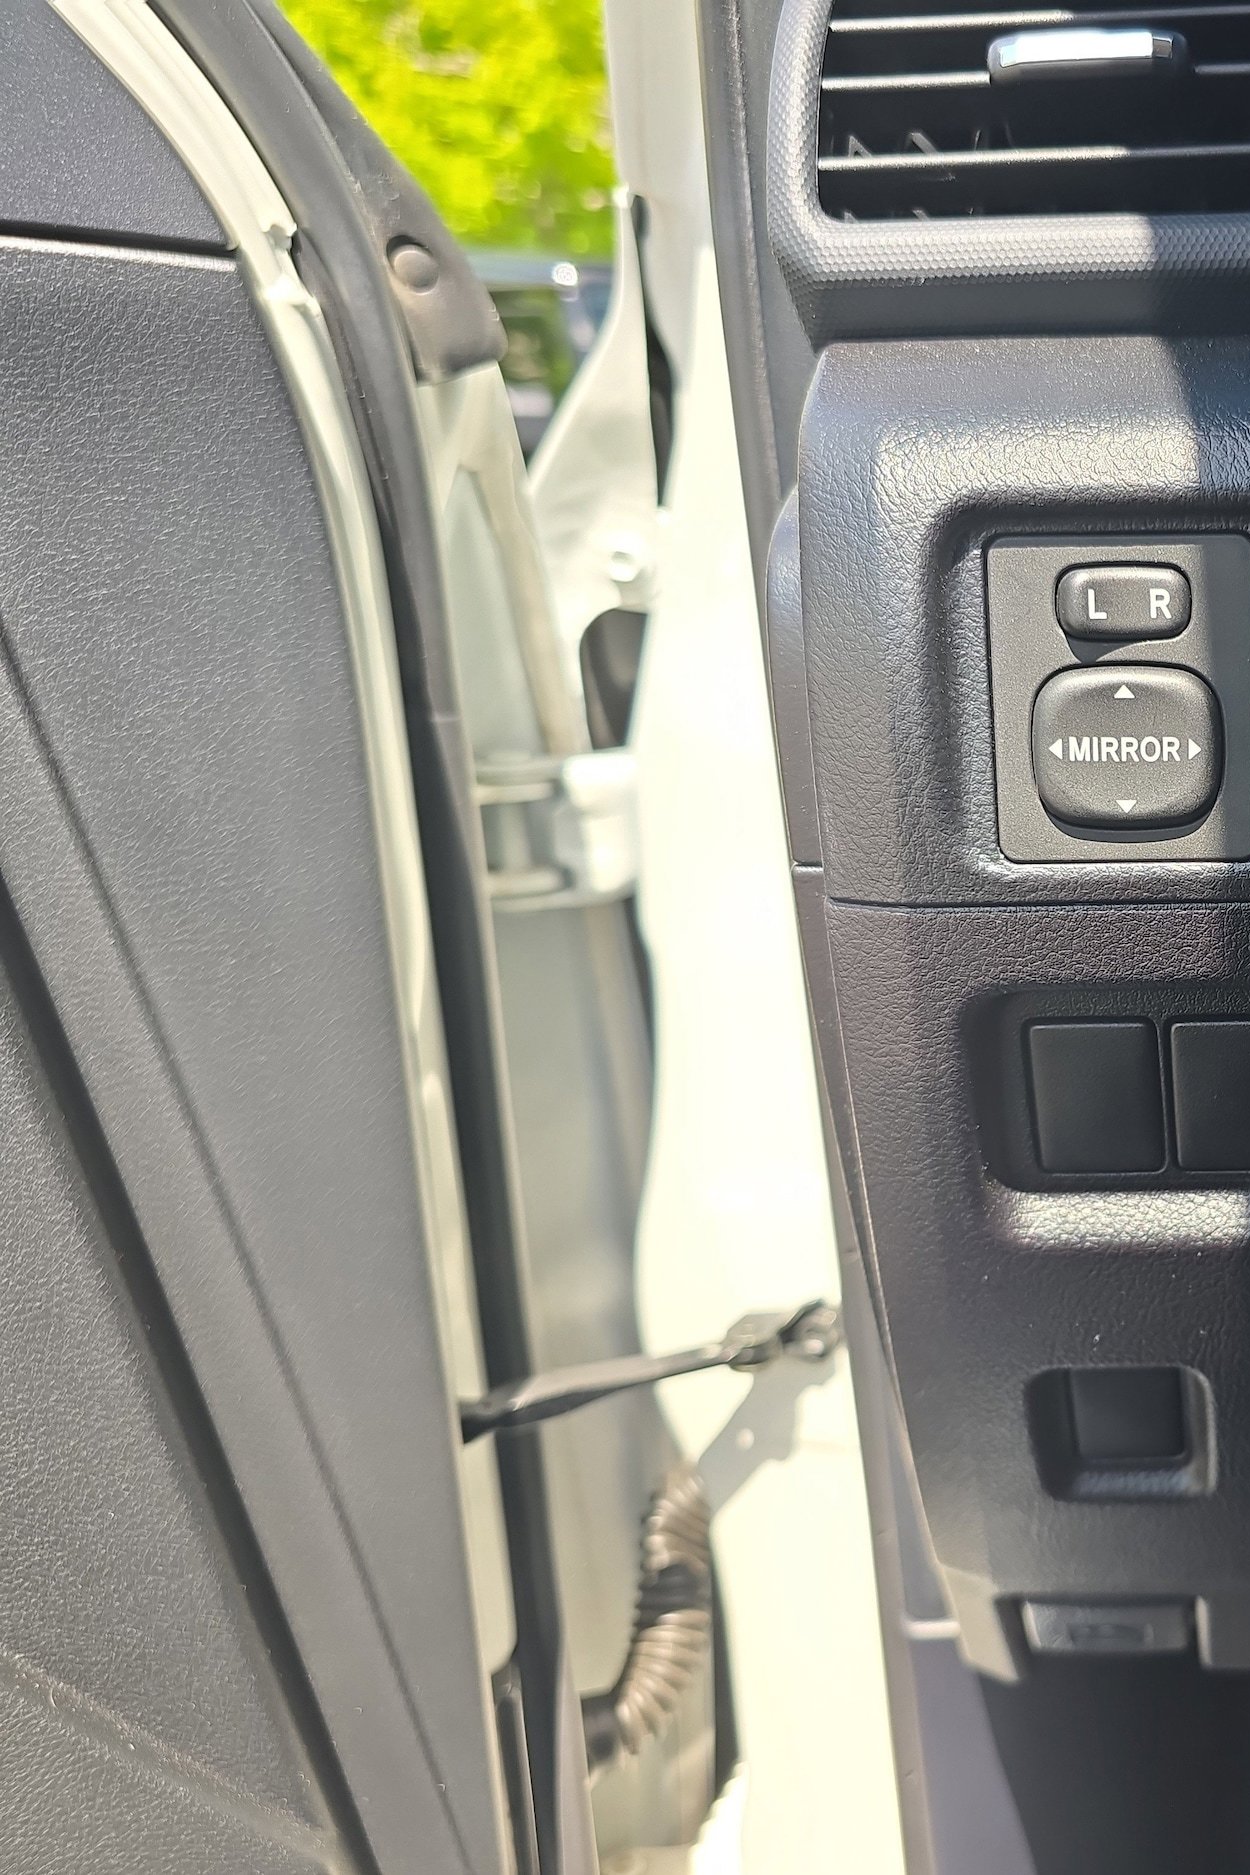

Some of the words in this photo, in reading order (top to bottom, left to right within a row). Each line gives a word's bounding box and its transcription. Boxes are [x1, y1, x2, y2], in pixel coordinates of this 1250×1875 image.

[1086, 588, 1108, 620] L
[1149, 587, 1173, 620] R
[1068, 735, 1182, 763] MIRROR
